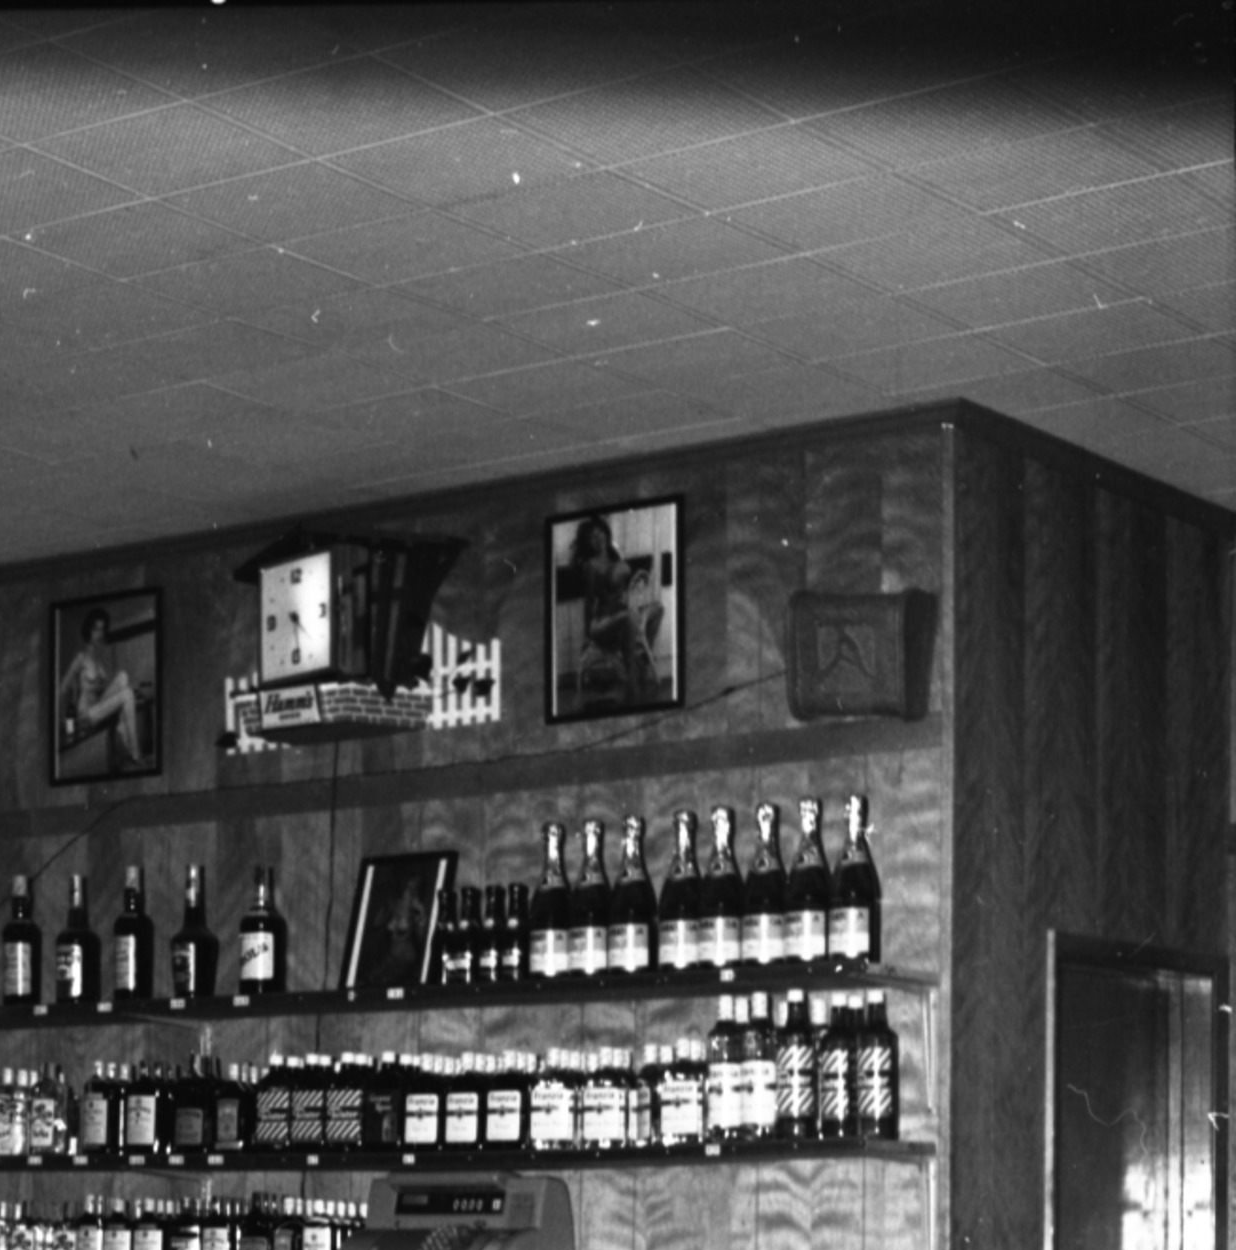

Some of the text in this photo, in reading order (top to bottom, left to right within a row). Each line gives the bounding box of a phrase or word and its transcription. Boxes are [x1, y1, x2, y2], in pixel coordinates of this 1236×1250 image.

[290, 567, 303, 585] 12
[319, 602, 327, 618] 3
[266, 615, 277, 632] 9
[291, 648, 301, 665] 6
